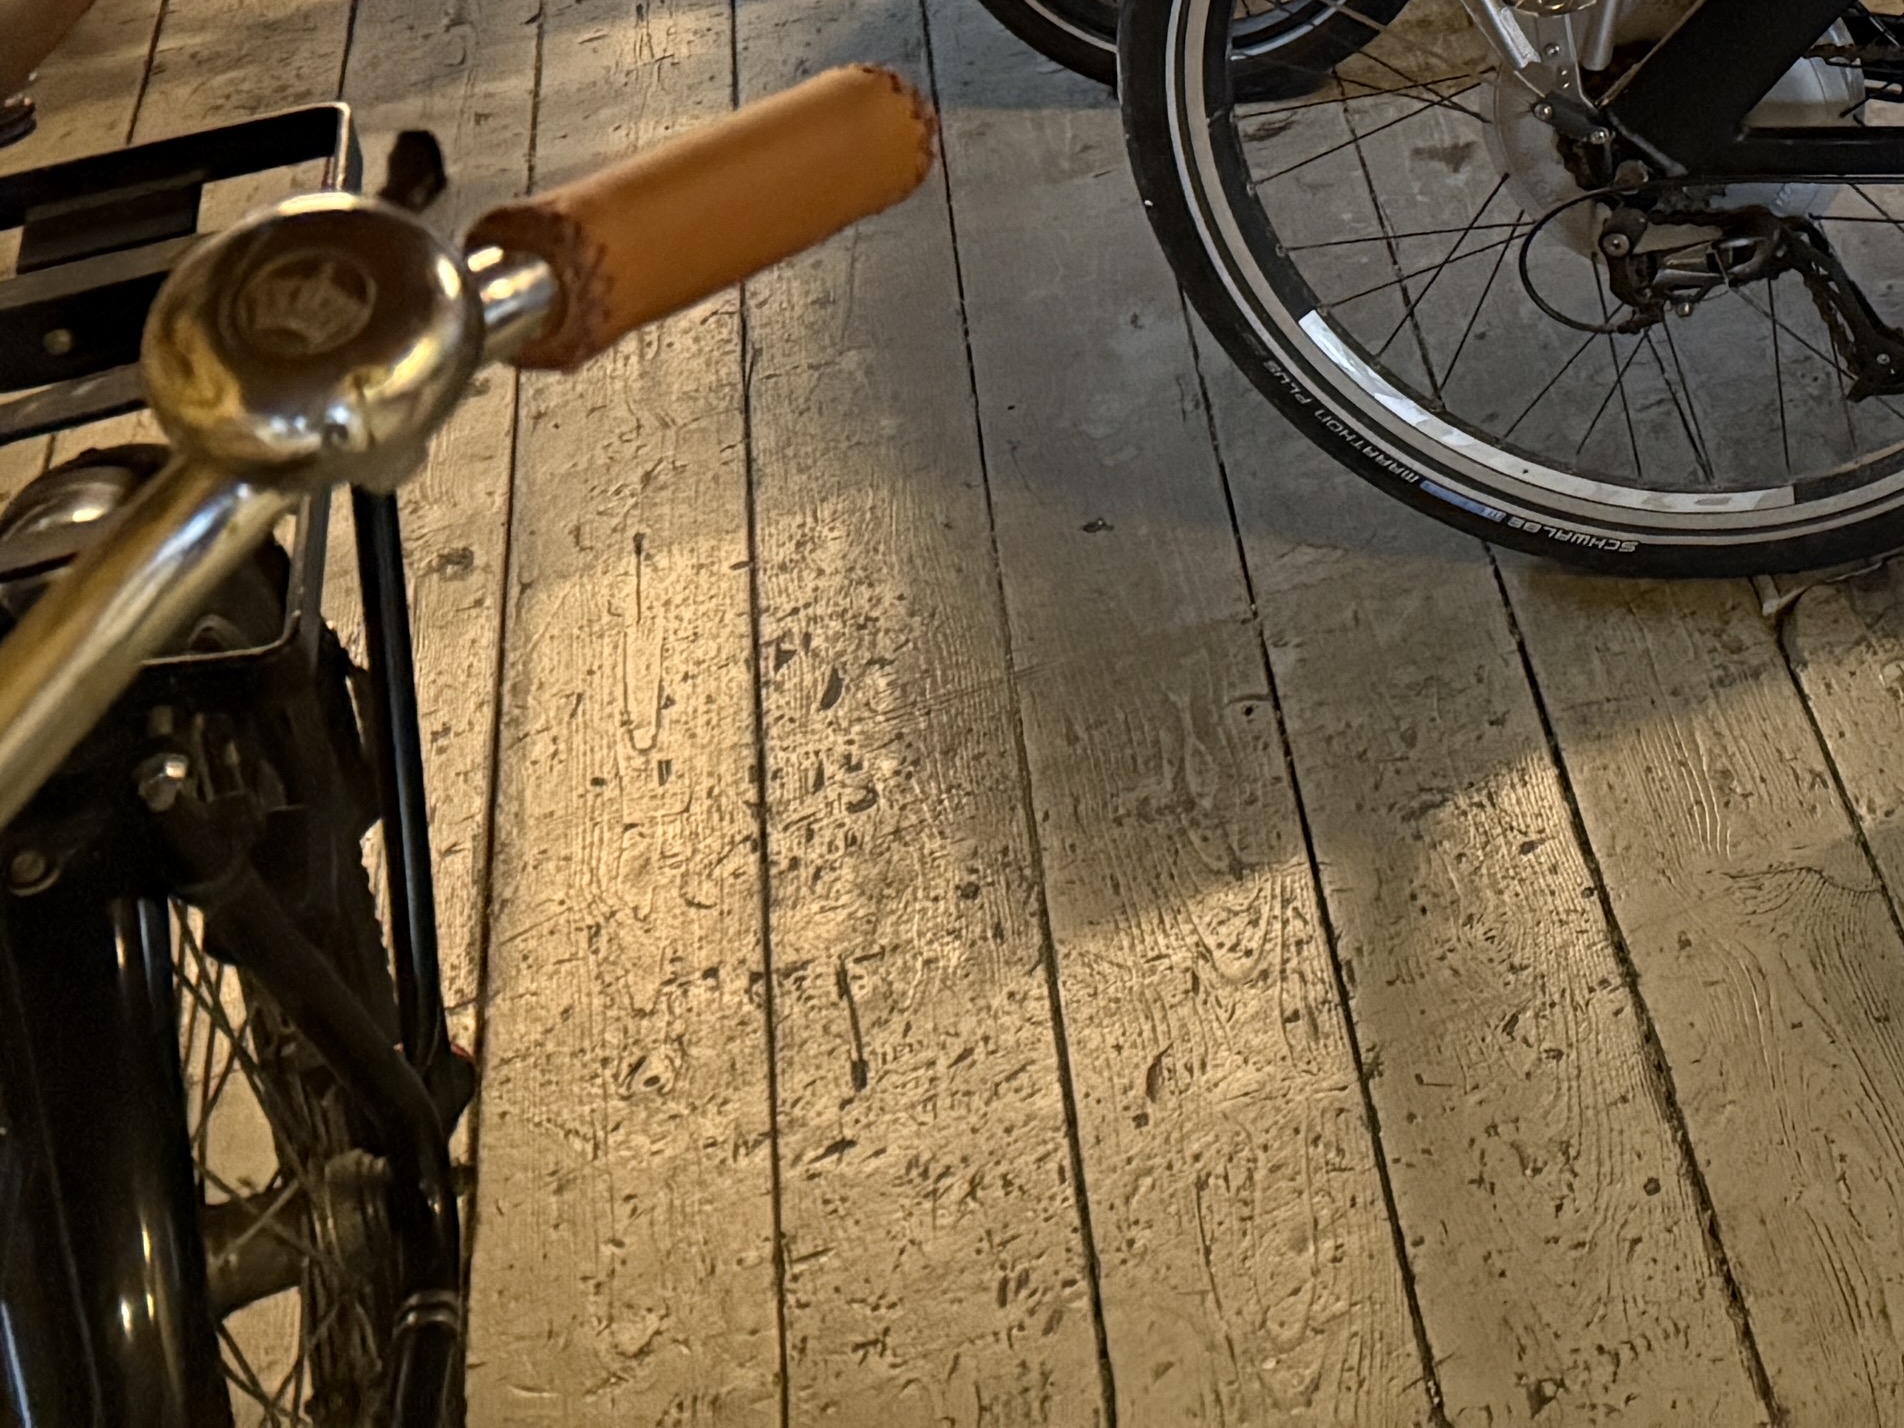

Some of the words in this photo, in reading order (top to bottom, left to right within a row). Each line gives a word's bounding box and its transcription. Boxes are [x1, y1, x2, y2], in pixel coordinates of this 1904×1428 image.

[1262, 359, 1312, 405] PLUS
[1313, 408, 1421, 485] MARATHON
[1507, 515, 1640, 554] SCHWALBE
